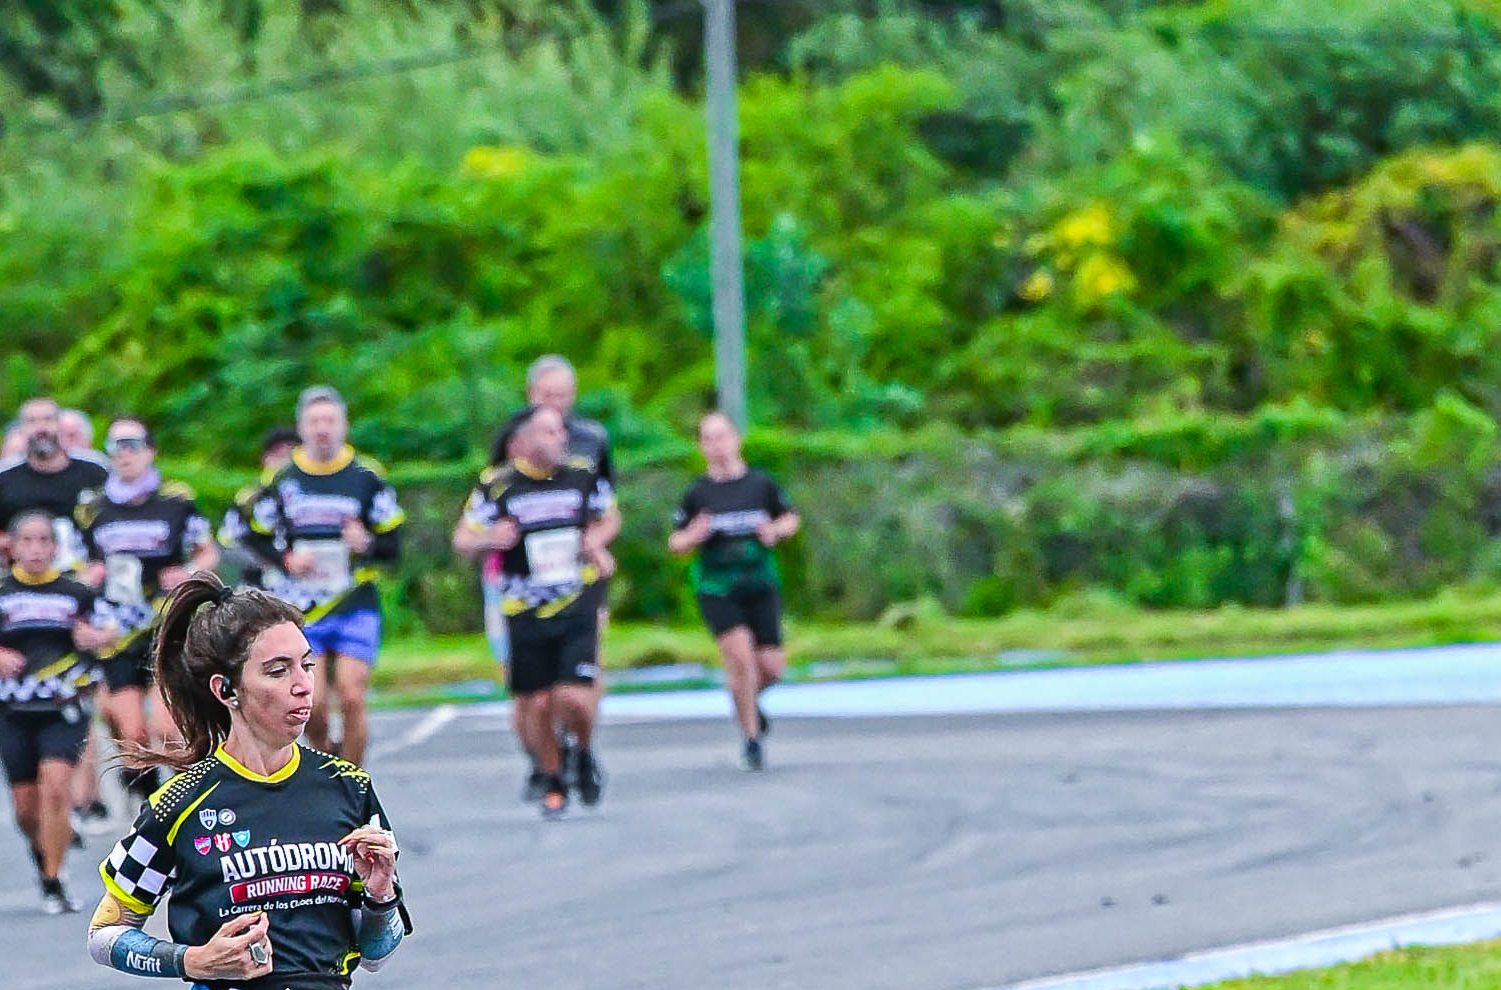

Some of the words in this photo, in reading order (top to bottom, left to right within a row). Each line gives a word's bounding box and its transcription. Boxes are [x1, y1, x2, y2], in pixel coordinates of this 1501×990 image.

[246, 875, 307, 899] RUNNING
[310, 875, 344, 891] RACE
[219, 907, 230, 917] La
[230, 903, 262, 914] Carrera
[263, 901, 275, 910] de
[275, 900, 289, 909] los
